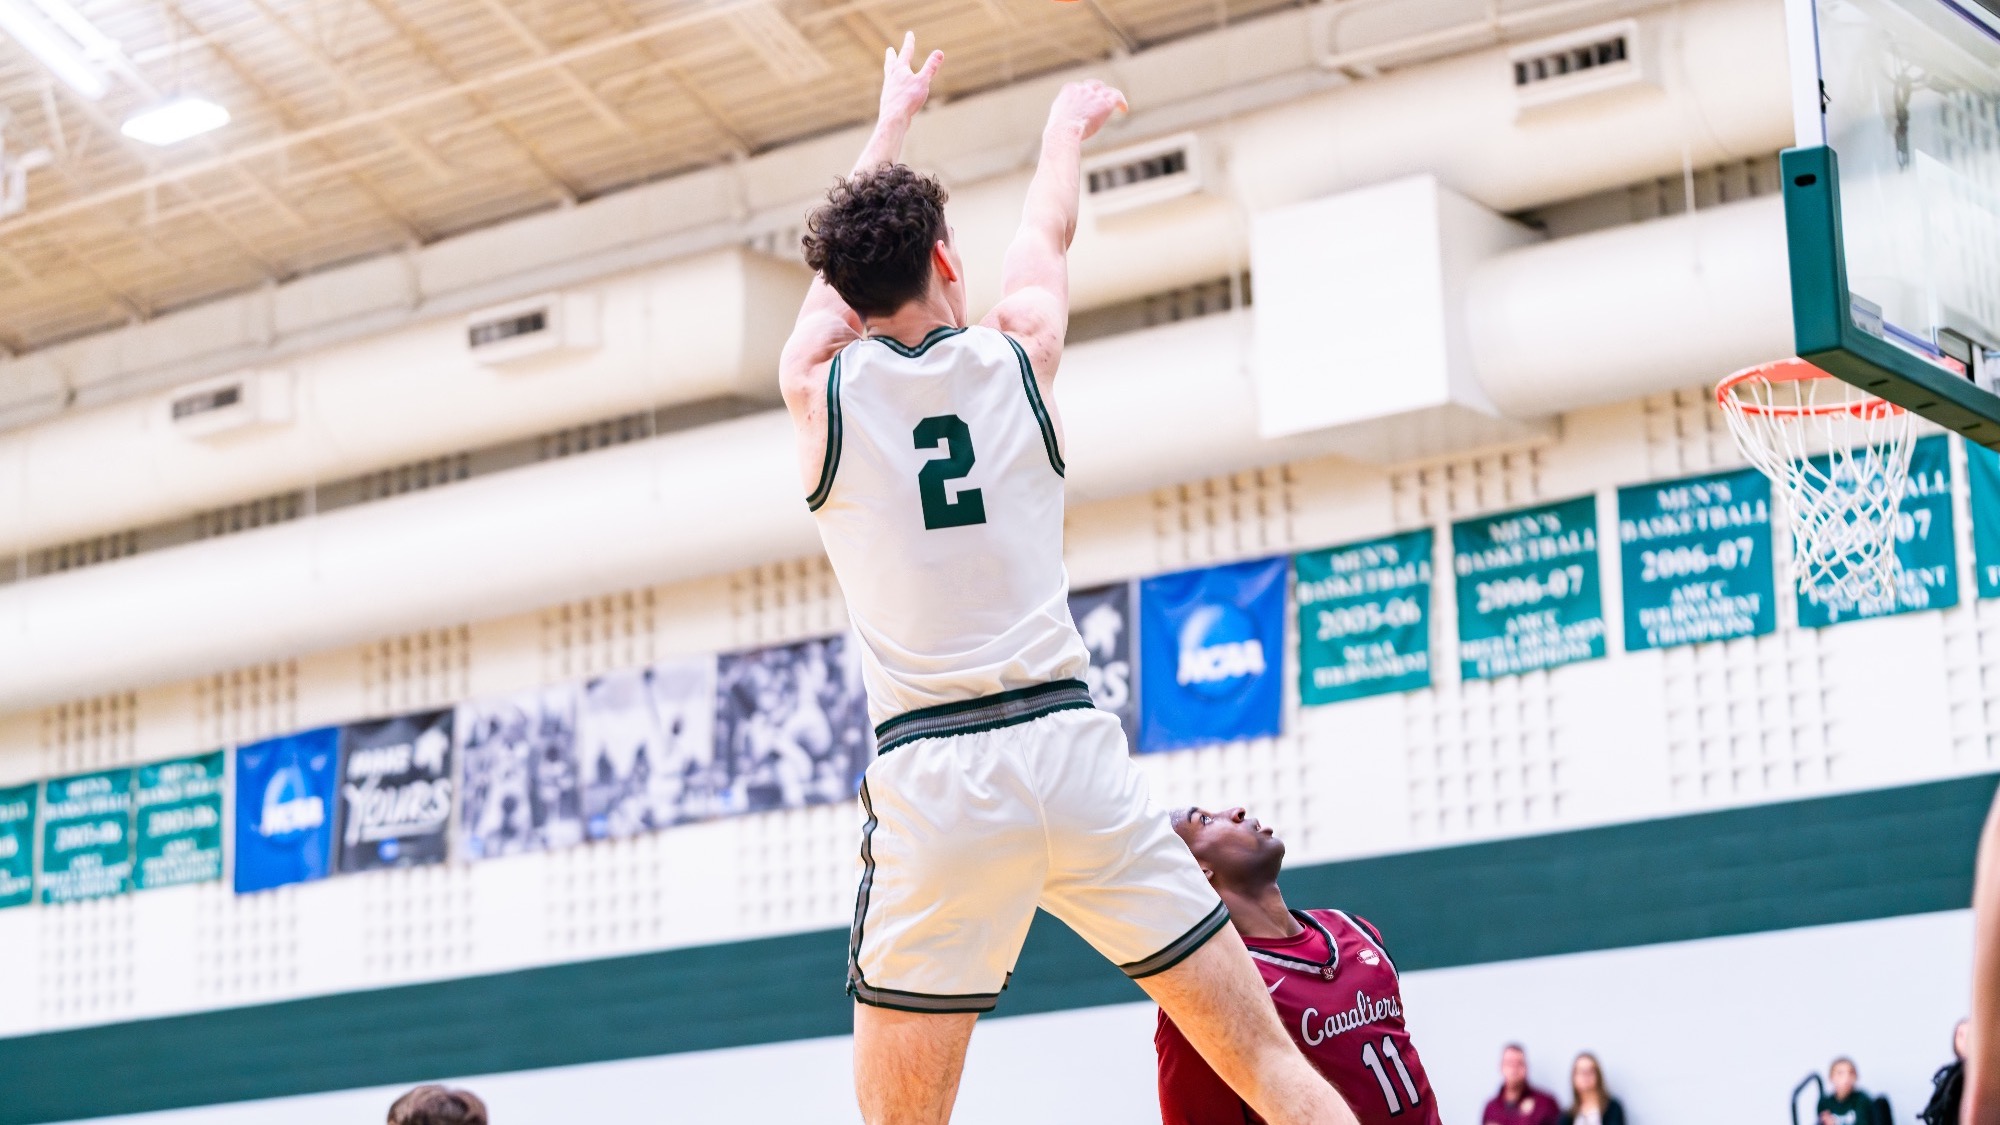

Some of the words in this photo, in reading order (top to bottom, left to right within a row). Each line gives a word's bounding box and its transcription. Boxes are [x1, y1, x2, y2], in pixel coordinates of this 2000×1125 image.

[913, 414, 987, 530] 2
[1657, 481, 1732, 511] MEN'S
[1488, 512, 1561, 543] MEN'S
[1620, 499, 1768, 543] BASKETBALL
[1331, 544, 1399, 573] MEN'S
[1455, 527, 1595, 577] BASKETBALL
[1641, 536, 1753, 582] 2006-07
[1296, 560, 1432, 606] BASKETBALL
[1476, 564, 1583, 614] 2006-07
[1317, 596, 1421, 641] 2005-06
[1177, 639, 1266, 686] NCAA
[260, 796, 324, 836] NCAA
[1301, 990, 1401, 1047] Cavaliers
[1360, 1034, 1422, 1117] 11
